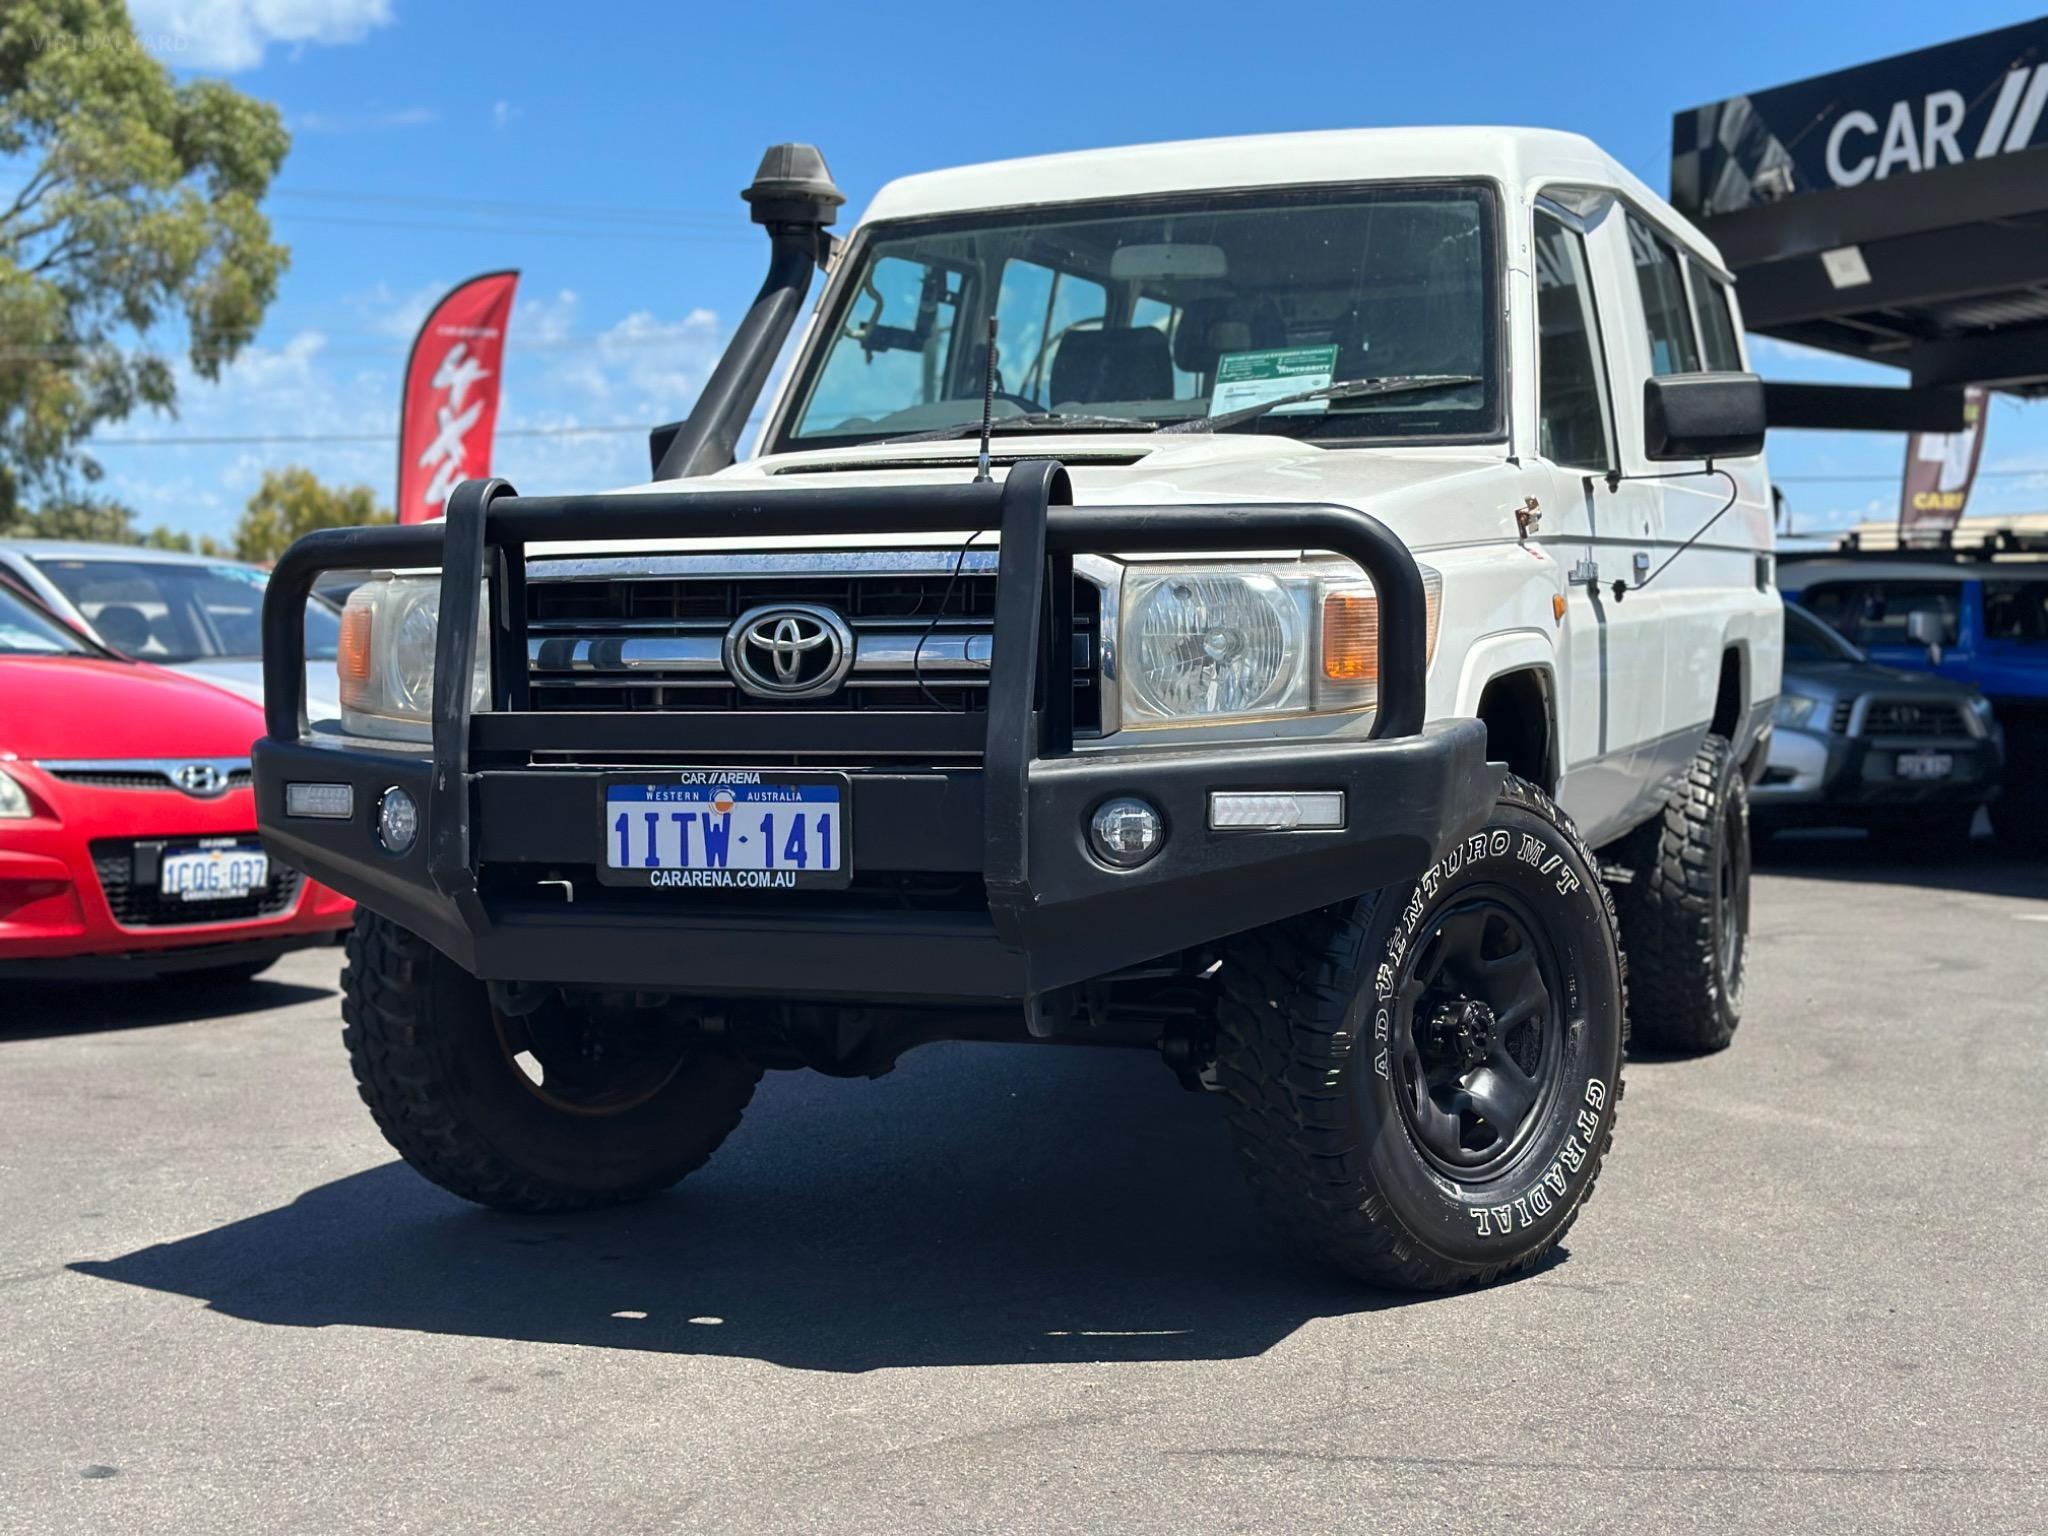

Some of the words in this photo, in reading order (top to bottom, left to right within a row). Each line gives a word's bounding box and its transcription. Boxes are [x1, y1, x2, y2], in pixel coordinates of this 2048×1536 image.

[646, 792, 699, 801] WESTERN
[747, 792, 802, 801] AUSTRALIA
[650, 870, 796, 888] CARARENA.COM.AU
[1375, 830, 1511, 1080] ADVENTURO
[1517, 833, 1580, 896] M/T
